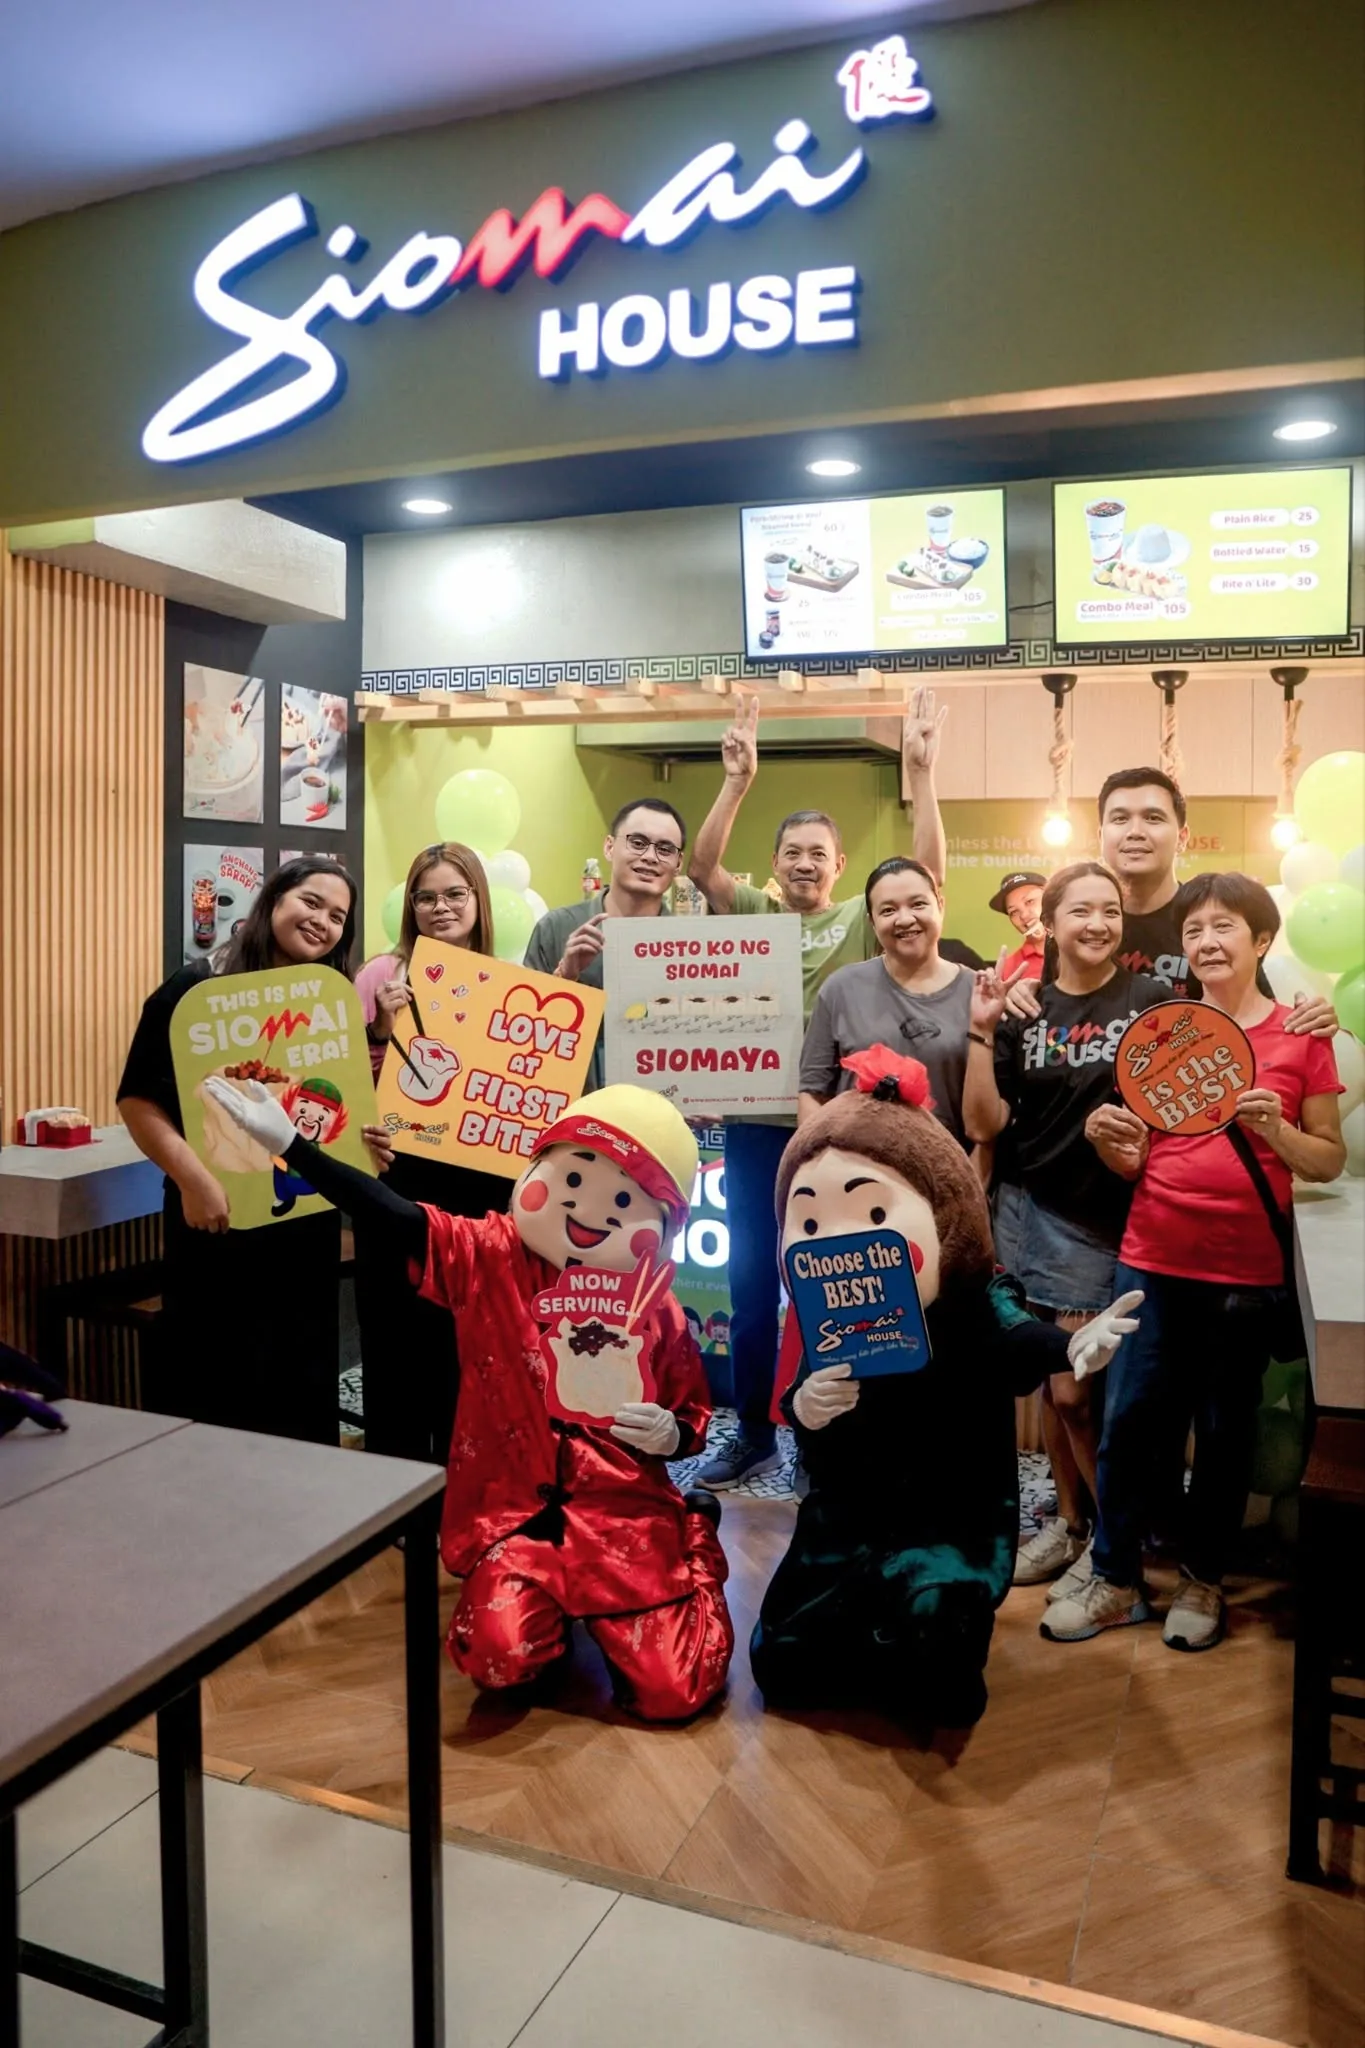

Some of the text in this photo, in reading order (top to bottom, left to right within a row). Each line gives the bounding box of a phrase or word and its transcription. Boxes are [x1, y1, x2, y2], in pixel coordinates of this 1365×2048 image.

[142, 119, 865, 464] Siomai
[538, 265, 857, 379] HOUSE
[1224, 513, 1276, 525] Plain Rice
[1298, 511, 1312, 522] 25
[1254, 546, 1287, 556] Water
[1298, 544, 1311, 553] 15
[1256, 578, 1277, 588] Lite
[1296, 576, 1312, 586] 30
[963, 592, 982, 602] 105
[1080, 601, 1154, 613] Combo Meal
[1163, 603, 1187, 614] 105
[945, 836, 990, 850] nless
[994, 836, 1021, 850] the
[948, 853, 978, 868] the
[983, 853, 1059, 868] builders
[634, 940, 771, 959] GUSTO KO NG
[665, 962, 740, 981] SIOMAI
[206, 979, 323, 1015] THIS IS MY
[188, 1000, 349, 1056] SIOMAI
[487, 1008, 581, 1061] LOVE
[1168, 1027, 1200, 1050] HOUSE
[286, 1034, 349, 1069] ERA!
[636, 1045, 781, 1076] SIOMAYA
[507, 1052, 543, 1079] AT
[1141, 1081, 1175, 1108] is
[1175, 1045, 1234, 1086] the
[463, 1069, 570, 1125] FIRST
[1155, 1062, 1247, 1130] BEST
[457, 1110, 548, 1158] BITE
[793, 1241, 903, 1280] Choose the
[569, 1273, 622, 1292] NOW
[822, 1275, 886, 1311] BEST!
[815, 1311, 899, 1353] Siomai
[866, 1330, 903, 1343] HOUSE
